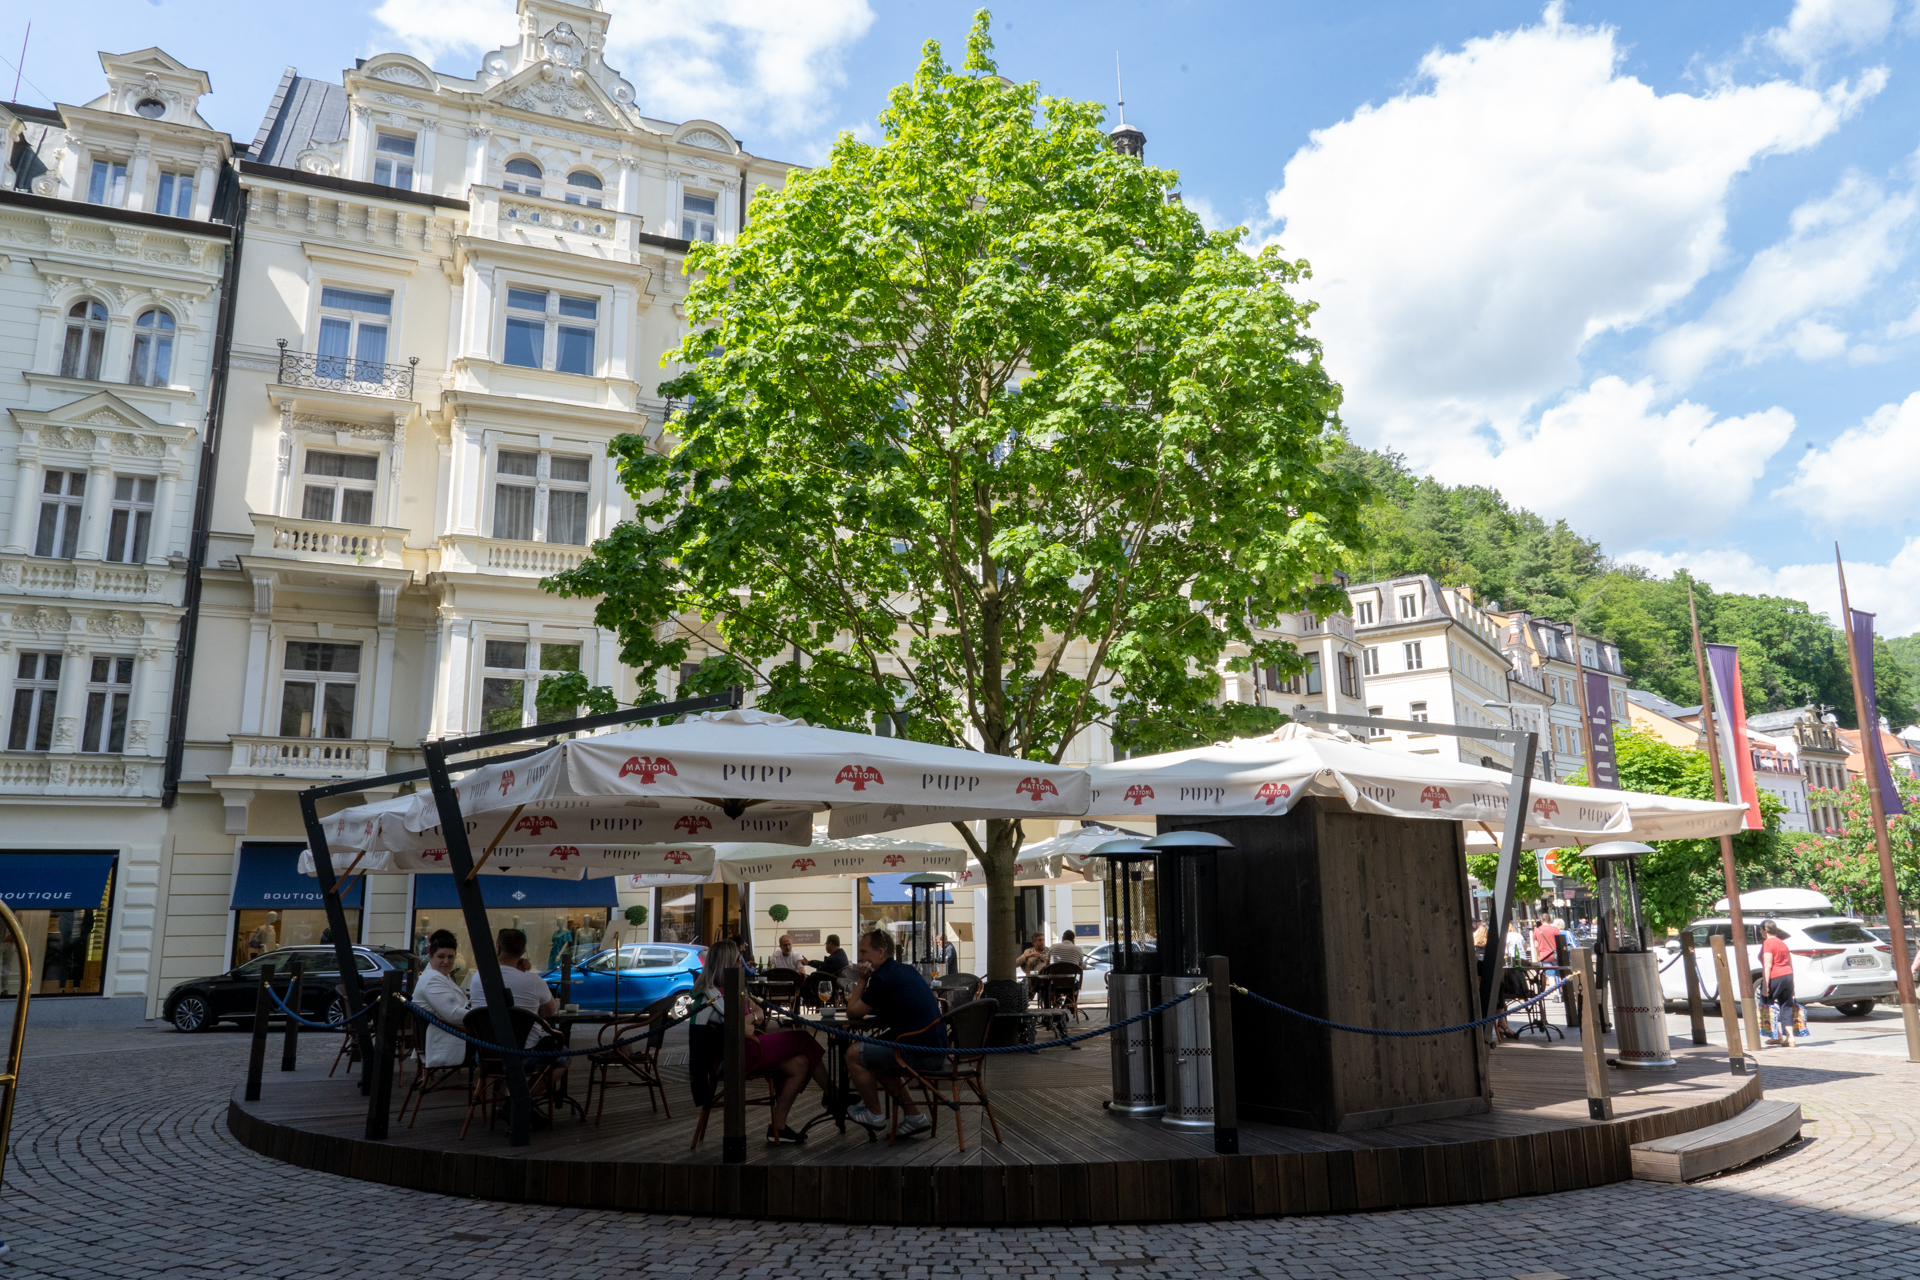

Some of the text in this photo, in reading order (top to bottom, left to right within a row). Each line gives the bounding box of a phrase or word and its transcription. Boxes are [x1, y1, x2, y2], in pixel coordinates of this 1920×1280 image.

[470, 781, 490, 800] PUPP
[527, 764, 551, 786] PUPP
[625, 763, 1054, 792] MATTONI PUPP MATTONI PUPP MATTONI
[1180, 787, 1225, 802] PUPP
[1260, 788, 1289, 796] MATTONI
[1472, 793, 1509, 810] PUPP
[1535, 803, 1557, 811] MATTONI
[419, 821, 478, 838] PUP
[590, 818, 643, 831] PUPP
[741, 819, 788, 831] PUPP
[603, 850, 641, 860] PUPP
[740, 863, 772, 875] PUPP
[833, 857, 865, 867] PUPP
[922, 856, 951, 865] PUPP
[263, 892, 324, 900] BOUTIQU
